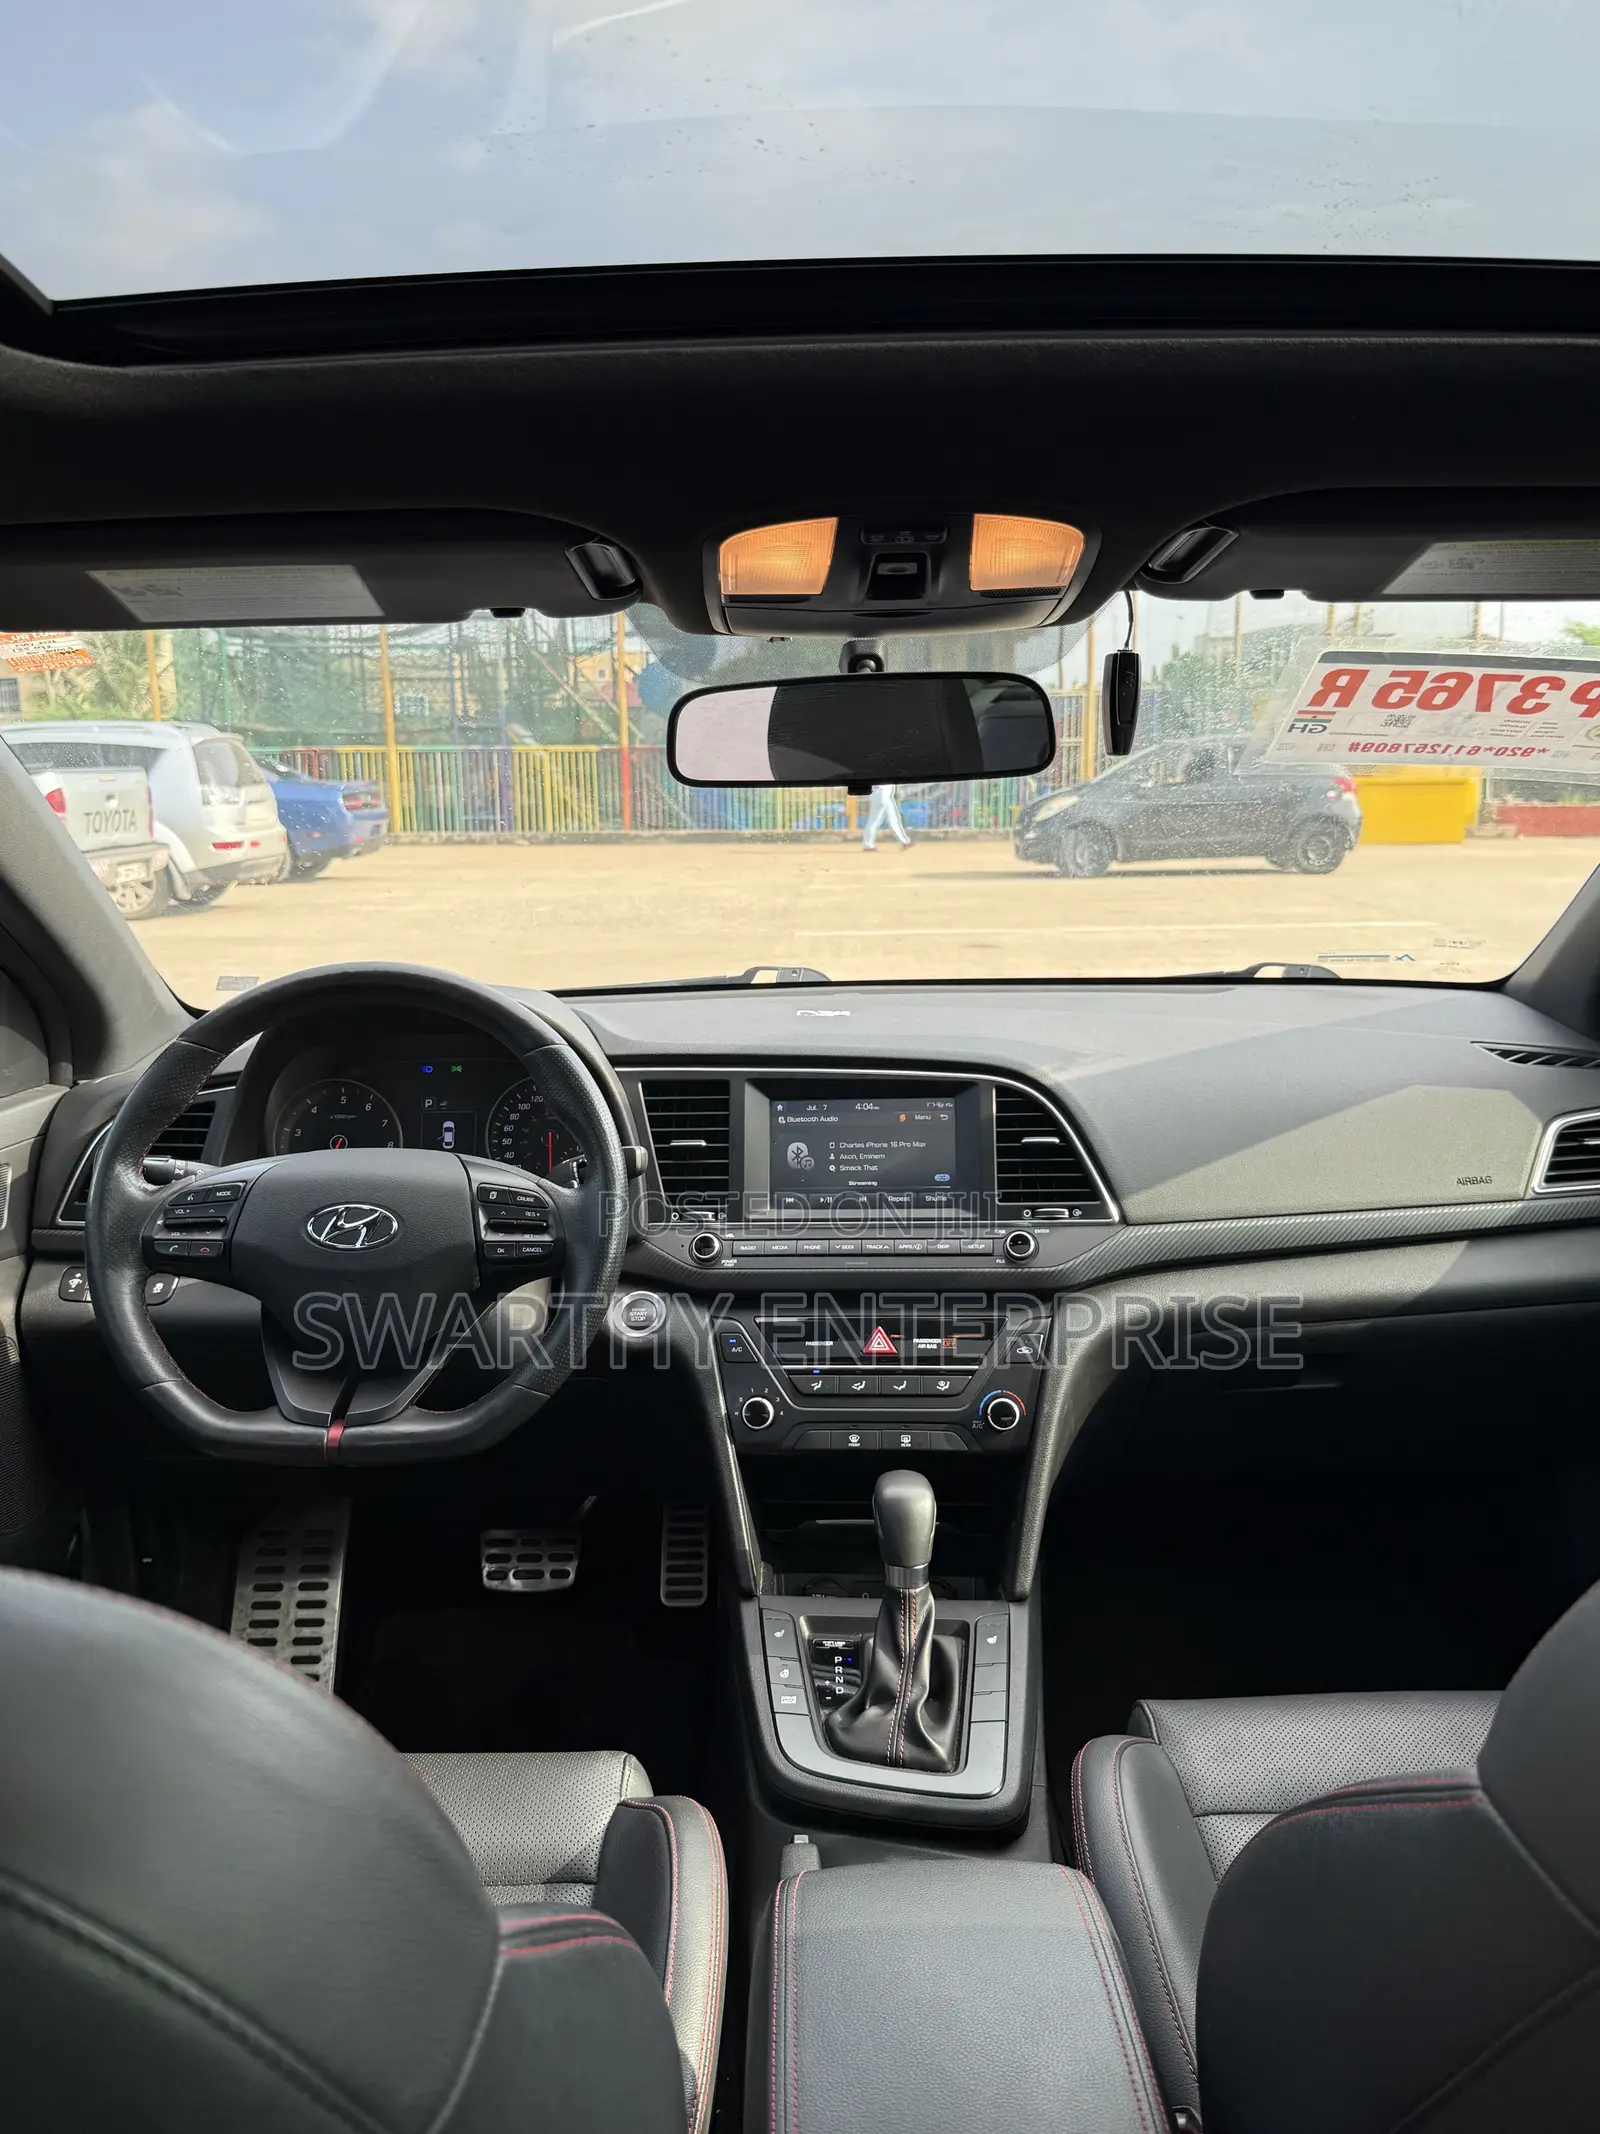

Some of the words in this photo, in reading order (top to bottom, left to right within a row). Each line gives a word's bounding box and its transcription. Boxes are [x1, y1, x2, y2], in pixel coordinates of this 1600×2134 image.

[84, 808, 138, 834] TOYOTA
[340, 1096, 347, 1104] 5
[425, 1098, 433, 1108] P
[310, 1105, 318, 1114] 4
[365, 1103, 372, 1111] 6
[382, 1119, 389, 1128] 7
[294, 1128, 302, 1137] 3
[502, 1137, 512, 1145] 50
[1456, 1175, 1493, 1186] AIRBAG
[834, 1656, 842, 1664] P
[834, 1666, 843, 1674] R
[835, 1676, 844, 1684] N
[836, 1686, 844, 1694] D
